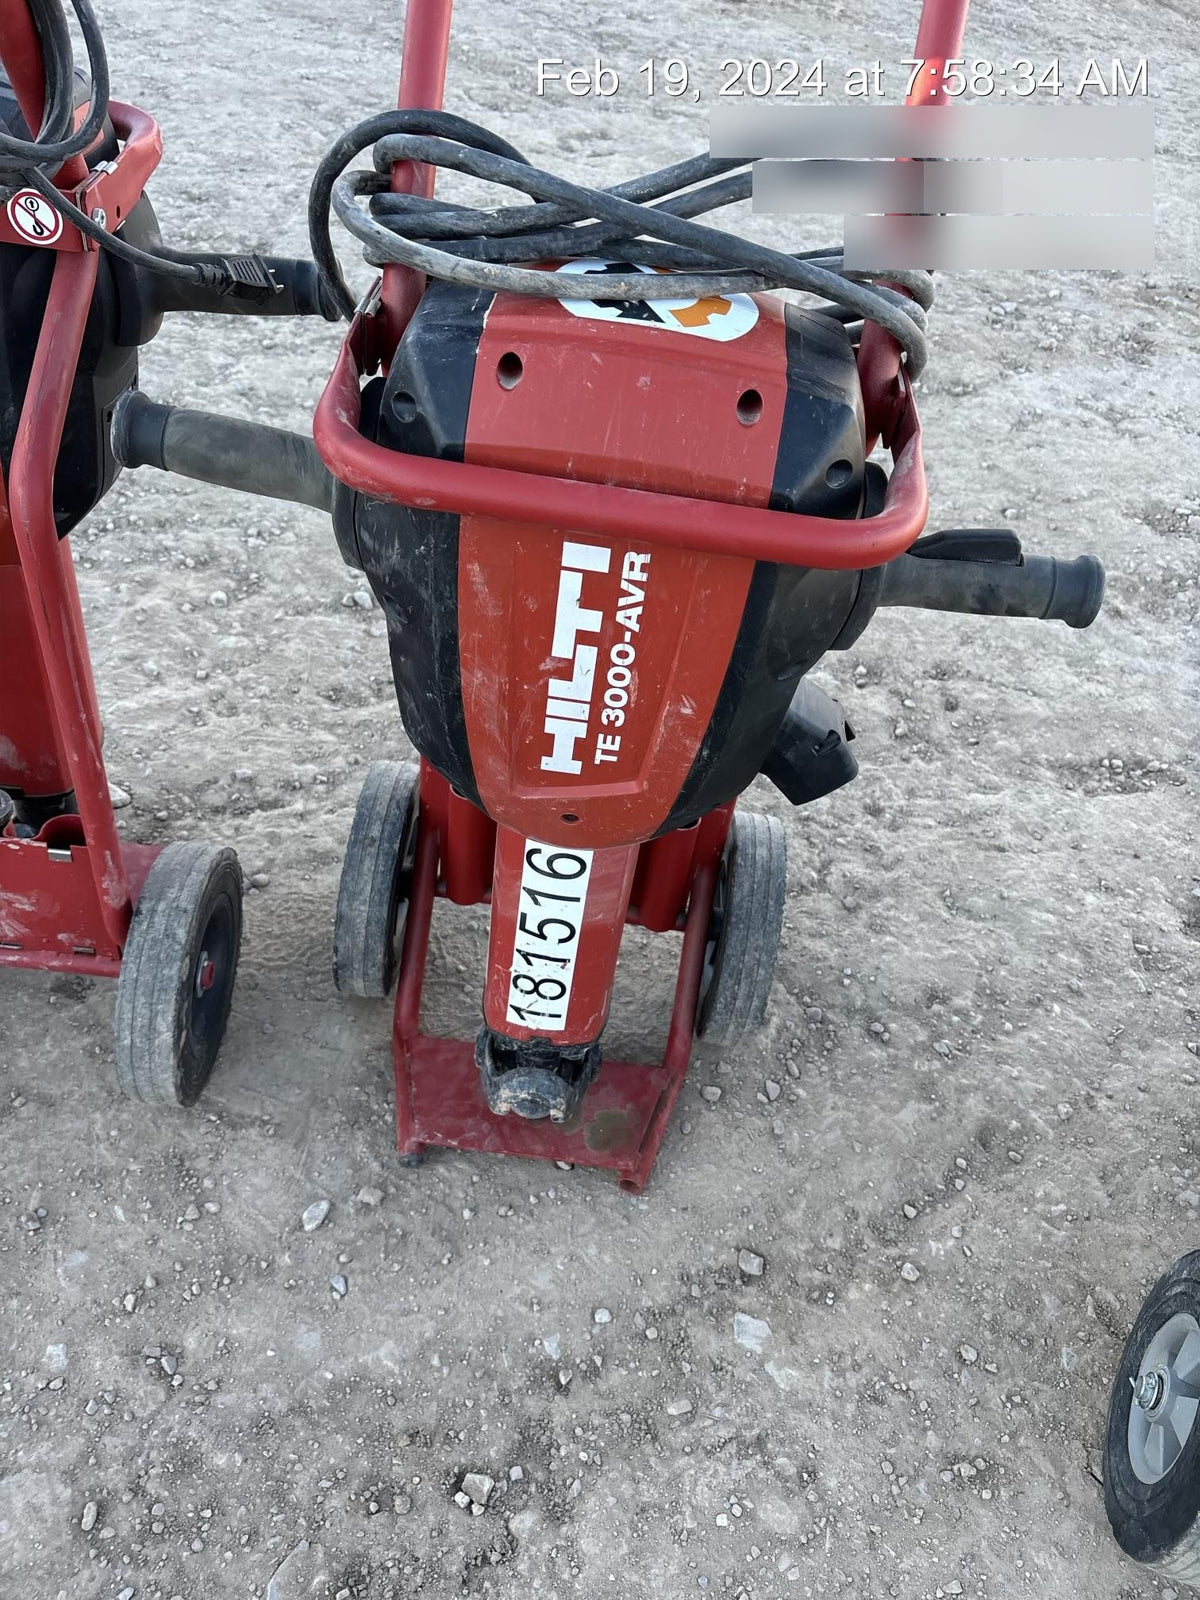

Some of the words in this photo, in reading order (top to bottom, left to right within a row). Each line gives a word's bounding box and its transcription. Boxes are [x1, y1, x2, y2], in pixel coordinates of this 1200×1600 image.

[540, 541, 612, 776] HILTI
[600, 551, 652, 728] 3000-AVR
[593, 732, 622, 765] TE
[508, 847, 589, 1022] 181516
